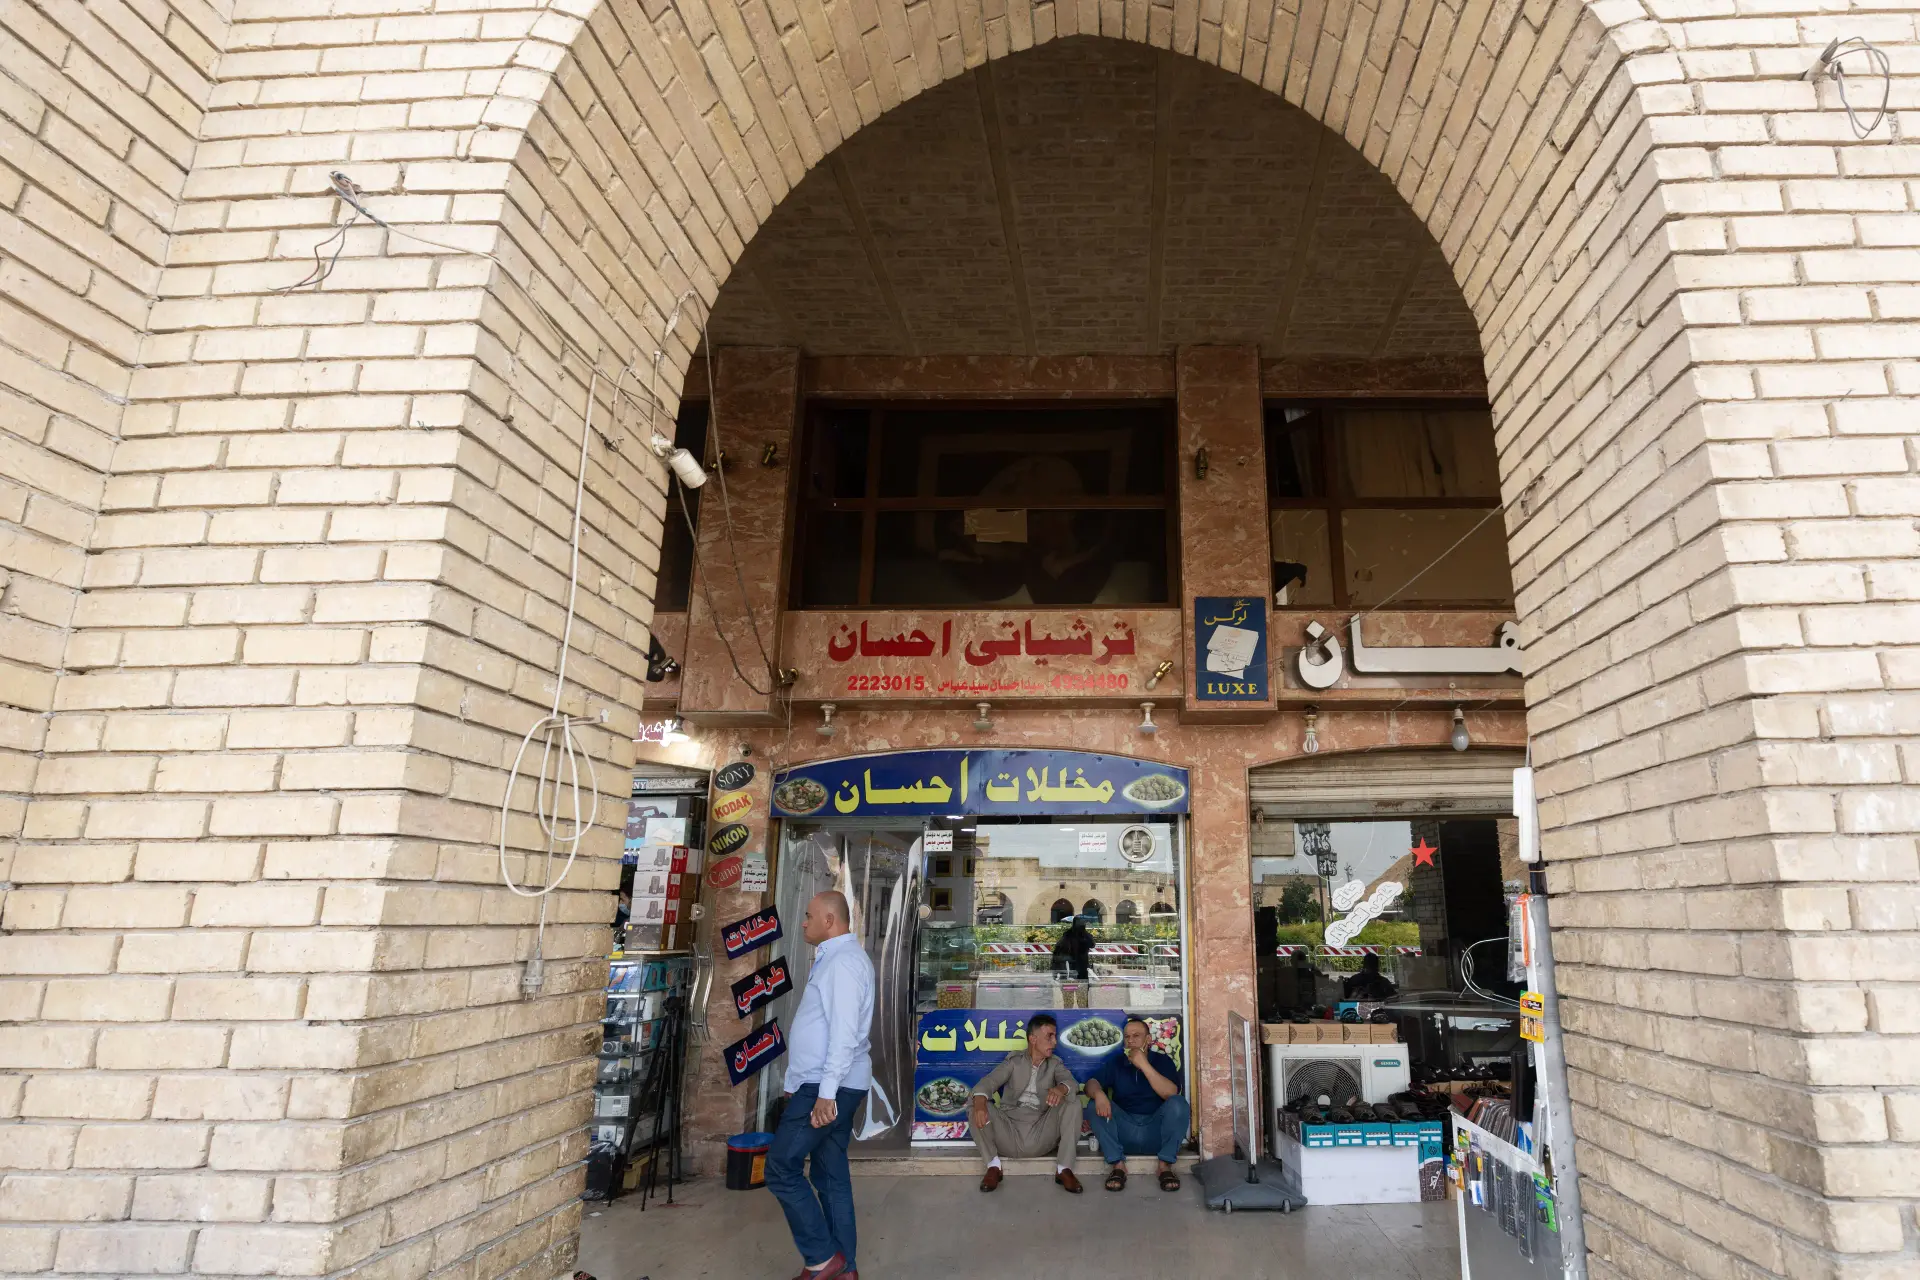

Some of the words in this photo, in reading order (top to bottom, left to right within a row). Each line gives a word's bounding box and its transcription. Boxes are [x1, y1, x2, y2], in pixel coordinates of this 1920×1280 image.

[828, 619, 952, 662] احسان
[847, 675, 925, 692] 2223015
[1207, 683, 1258, 695] LUXE
[632, 781, 647, 790] NY
[718, 765, 751, 788] SONY
[834, 757, 969, 813] احسان
[985, 766, 1115, 804] مخللات
[714, 795, 752, 819] KODAK
[711, 825, 748, 852] NIKON
[726, 915, 777, 952] مخللات
[738, 965, 786, 1013] طرشي
[734, 1021, 781, 1074] احسان
[921, 1018, 1027, 1052] خللات
